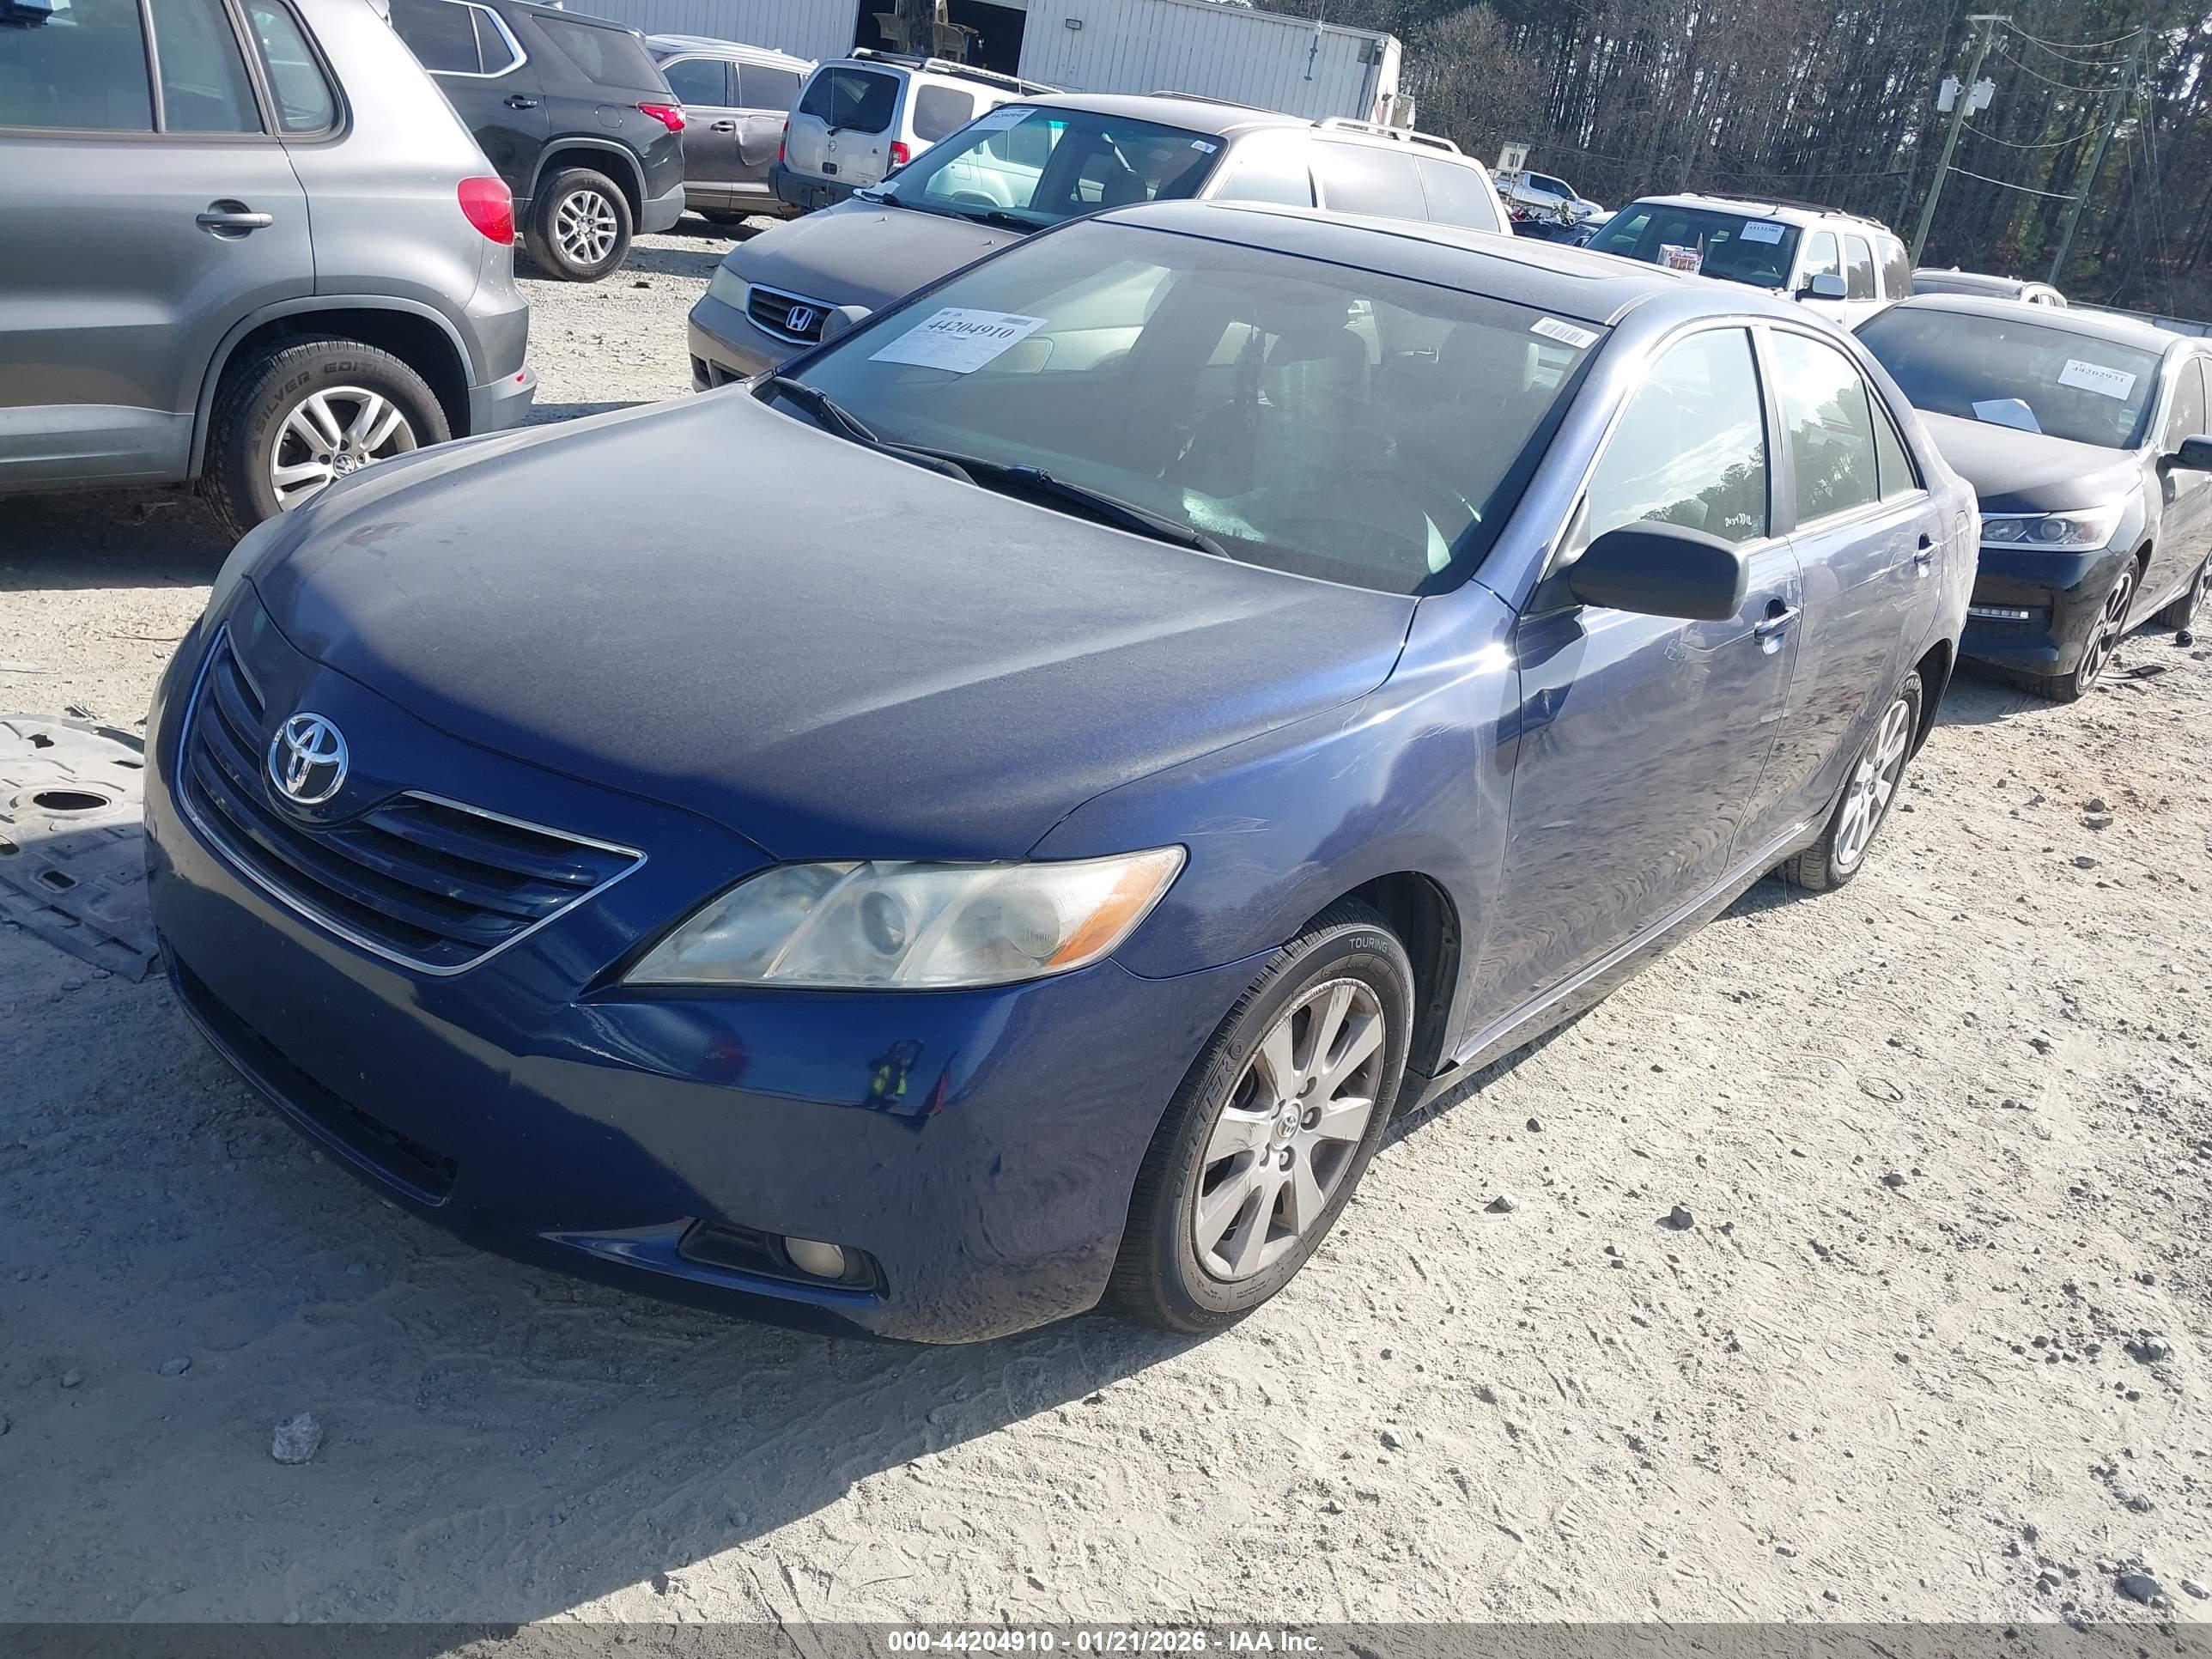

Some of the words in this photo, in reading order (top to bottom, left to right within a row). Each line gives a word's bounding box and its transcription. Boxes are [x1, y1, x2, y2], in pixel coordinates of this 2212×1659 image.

[928, 320, 1016, 339] 44204910
[256, 370, 310, 434] SILVER
[1349, 937, 1388, 953] TOURING
